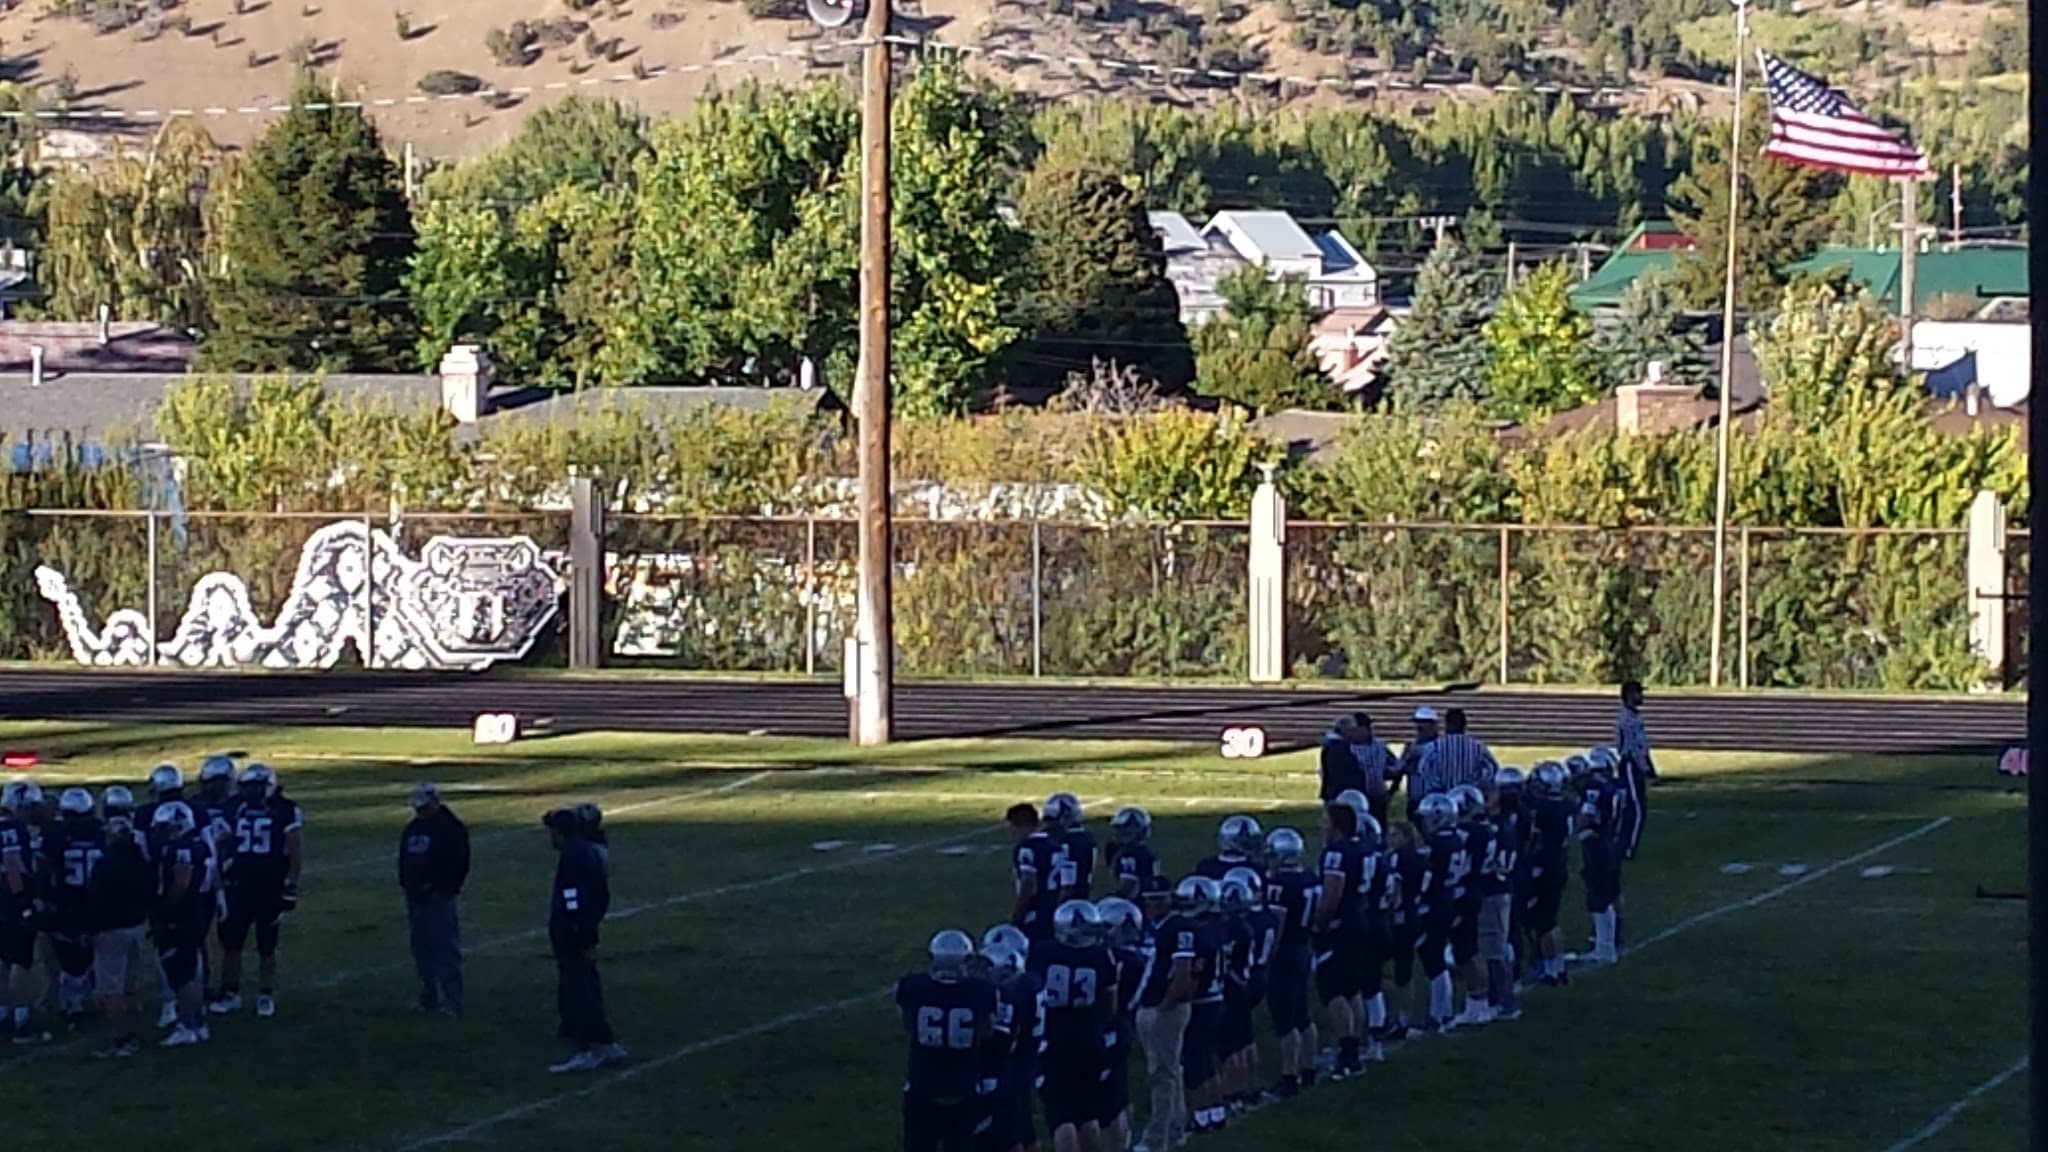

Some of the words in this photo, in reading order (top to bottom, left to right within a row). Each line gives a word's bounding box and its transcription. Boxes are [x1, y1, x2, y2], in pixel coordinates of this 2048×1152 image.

[1221, 727, 1265, 758] 30
[235, 816, 273, 854] 55
[1046, 963, 1097, 1008] 93
[916, 1004, 975, 1049] 66
